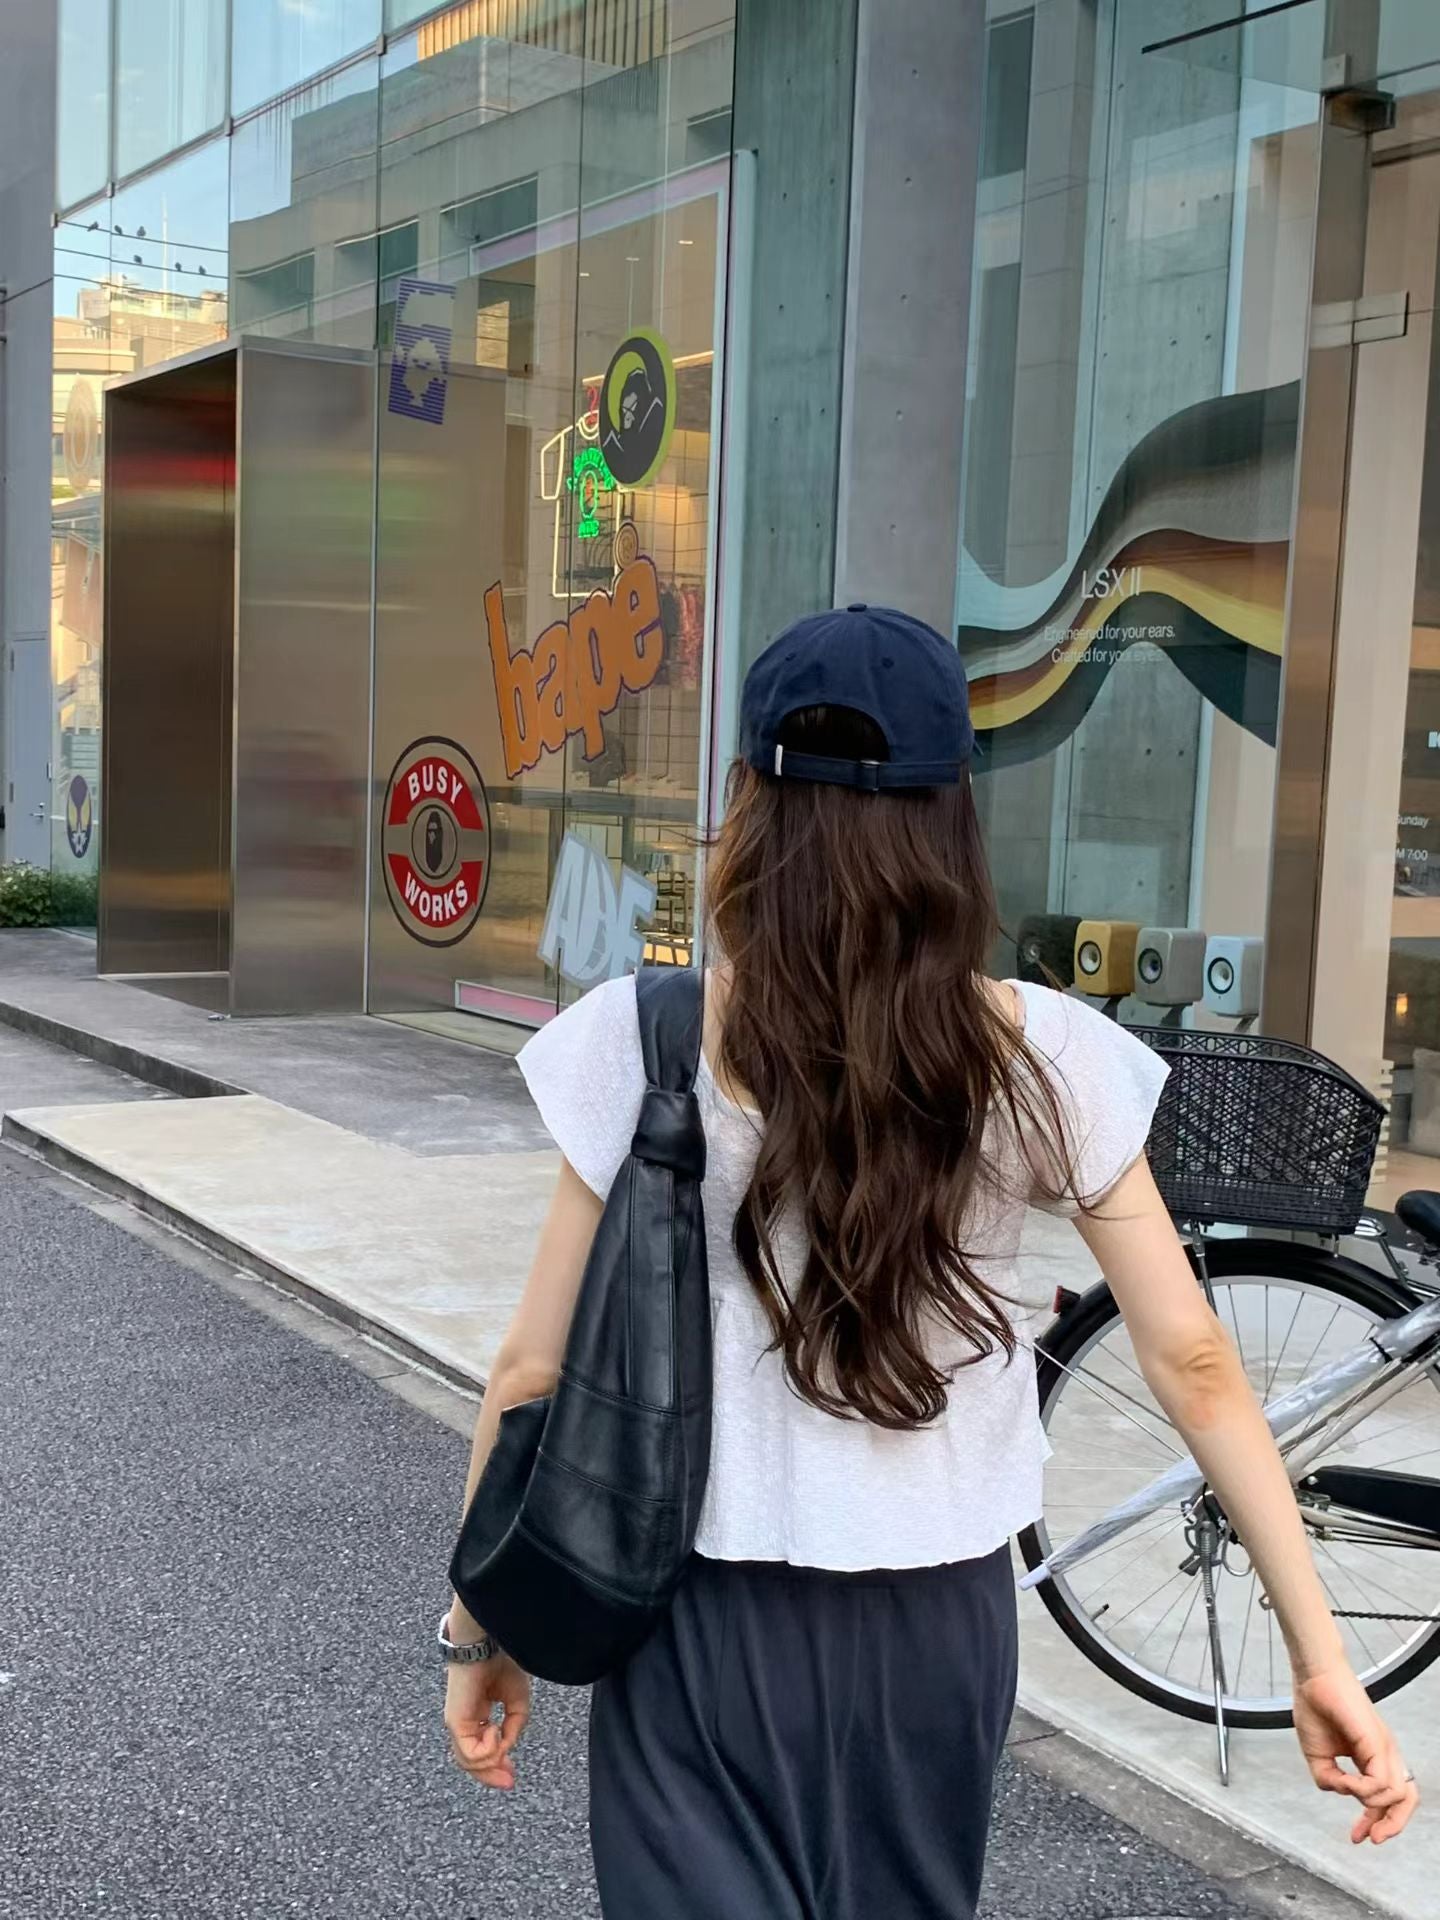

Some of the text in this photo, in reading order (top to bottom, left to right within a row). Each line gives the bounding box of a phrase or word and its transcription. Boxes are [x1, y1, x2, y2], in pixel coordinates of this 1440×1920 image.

[1081, 568, 1127, 599] LSX
[1105, 624, 1120, 640] for
[1121, 627, 1148, 642] your
[1148, 625, 1176, 639] ears.
[483, 554, 665, 780] bape
[1092, 648, 1108, 663] for
[407, 764, 463, 804] BUSY
[405, 872, 468, 921] WORKS
